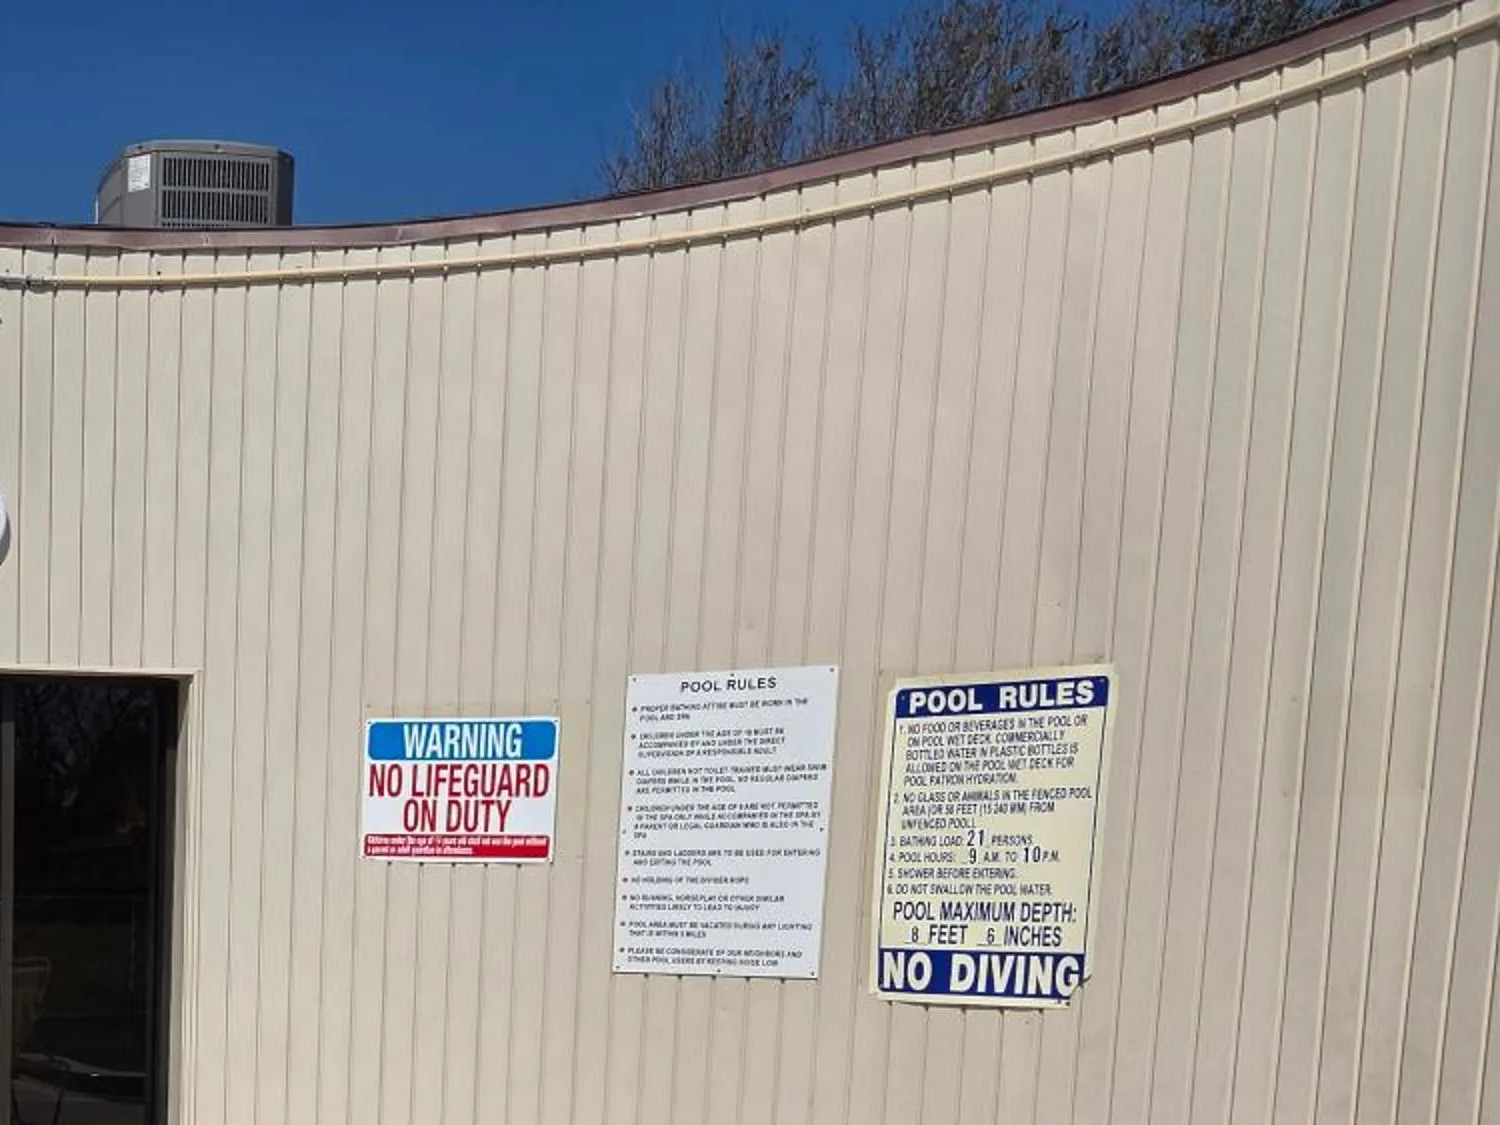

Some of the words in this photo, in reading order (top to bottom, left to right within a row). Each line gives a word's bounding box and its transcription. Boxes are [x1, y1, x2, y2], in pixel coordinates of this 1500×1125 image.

[680, 679, 722, 692] POOL
[726, 677, 777, 690] RULES
[908, 687, 984, 714] POOL
[998, 679, 1095, 709] RULES
[907, 724, 919, 734] NO
[922, 722, 945, 734] FOOD
[948, 721, 960, 732] OR
[962, 718, 1014, 732] BEVERAGES
[1027, 716, 1044, 728] THE
[1047, 715, 1072, 727] POOL
[1074, 714, 1087, 725] OR
[404, 723, 522, 758] WARNING
[907, 736, 920, 748] ON
[922, 735, 944, 747] POOL
[947, 734, 965, 746] WET
[995, 730, 1065, 744] COMMERCIALLY
[906, 748, 944, 761] BOTTLED
[947, 747, 977, 759] WATER
[989, 745, 1025, 757] PLASTIC
[1028, 743, 1068, 756] BOTTLES
[905, 761, 946, 774] ALLOWED
[949, 760, 961, 772] ON
[963, 760, 980, 771] THE
[982, 759, 1006, 771] POOL
[1029, 757, 1053, 769] DECK
[1055, 756, 1074, 768] FOR
[369, 764, 402, 797] NO
[412, 764, 549, 798] LIFEGUARD
[904, 775, 926, 786] POOL
[903, 792, 914, 803] NO
[918, 791, 945, 803] GLASS
[947, 791, 959, 802] OR
[1002, 790, 1011, 801] IN
[1012, 789, 1029, 801] THE
[1031, 788, 1066, 800] FENCED
[1069, 787, 1092, 799] POOL
[404, 800, 436, 832] ON
[446, 800, 512, 832] DUTY
[902, 804, 924, 816] AREA
[956, 803, 976, 815] FEET
[1029, 801, 1055, 813] FROM
[899, 836, 936, 846] BATHING
[966, 829, 984, 846] 21
[898, 852, 922, 862] POOL
[969, 848, 977, 864] 9
[1005, 851, 1017, 862] TO
[1023, 846, 1042, 862] 10
[897, 867, 934, 878] SHOWER
[936, 867, 970, 878] BEFORE
[896, 883, 908, 894] DO
[910, 883, 927, 894] NOT
[929, 883, 973, 894] SWALLOW
[975, 884, 992, 895] THE
[994, 884, 1016, 895] POOL
[892, 901, 935, 920] POOL
[939, 901, 1015, 921] MAXIMUM
[1019, 902, 1077, 922] DEPTH:
[910, 926, 919, 942] 8
[928, 924, 968, 944] FEET
[986, 928, 995, 944] 6
[1004, 926, 1062, 947] INCHES
[881, 950, 933, 991] NO
[949, 952, 1081, 998] DIVING
